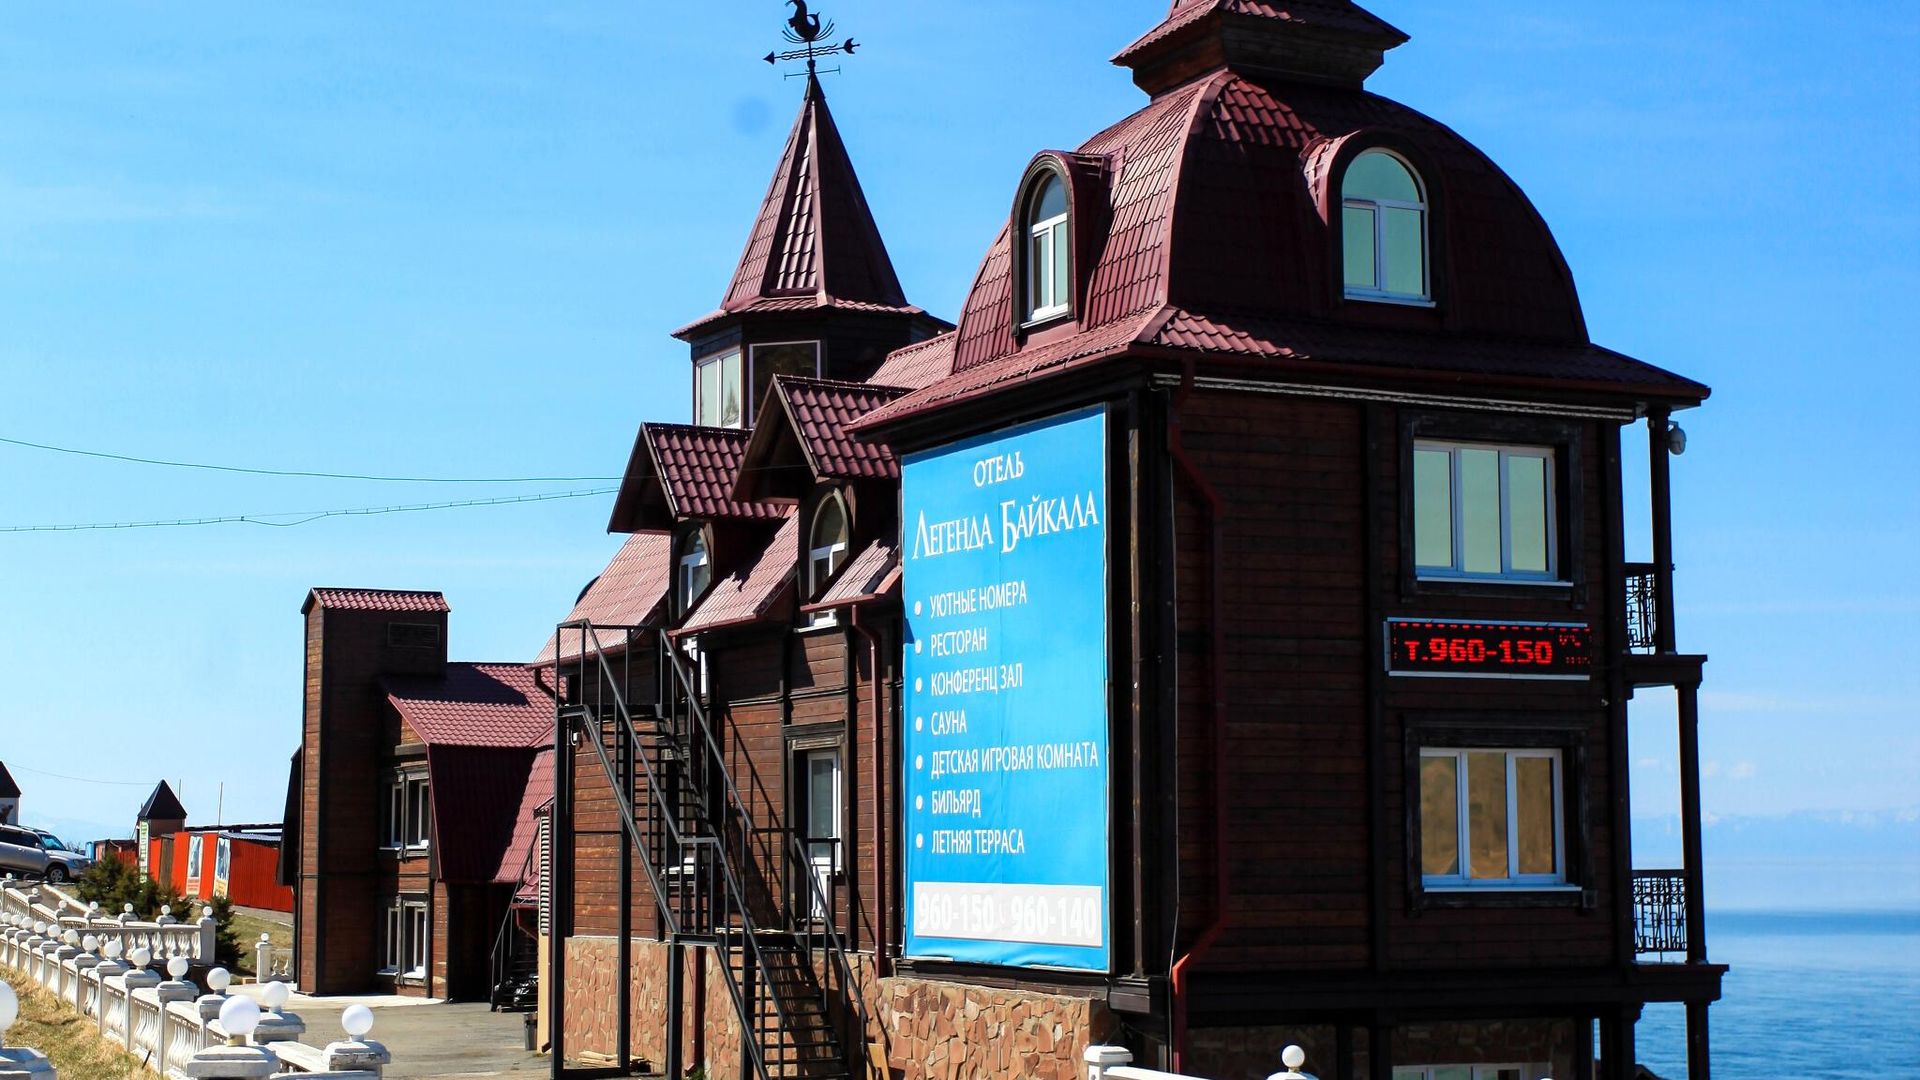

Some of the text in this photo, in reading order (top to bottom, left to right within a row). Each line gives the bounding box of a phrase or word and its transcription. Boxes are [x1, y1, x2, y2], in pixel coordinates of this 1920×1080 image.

[973, 451, 1024, 487] ОТЕЛЬ
[930, 580, 1027, 619] УЮТНЫЕ НОМЕРА
[930, 628, 987, 657] РЕСТОРАН
[930, 662, 1023, 696] КОНФЕРЕНЦ ЗАЛ
[931, 709, 967, 736] САУНА
[930, 741, 1099, 780] ДЕТСКАЯ ИГРОВАЯ КОМНАТА
[931, 789, 981, 818] БИЛЬЯРД
[931, 828, 1025, 855] ЛЕТНЯЯ ТЕРРАСА
[917, 891, 1098, 939] 960-150 960-140
